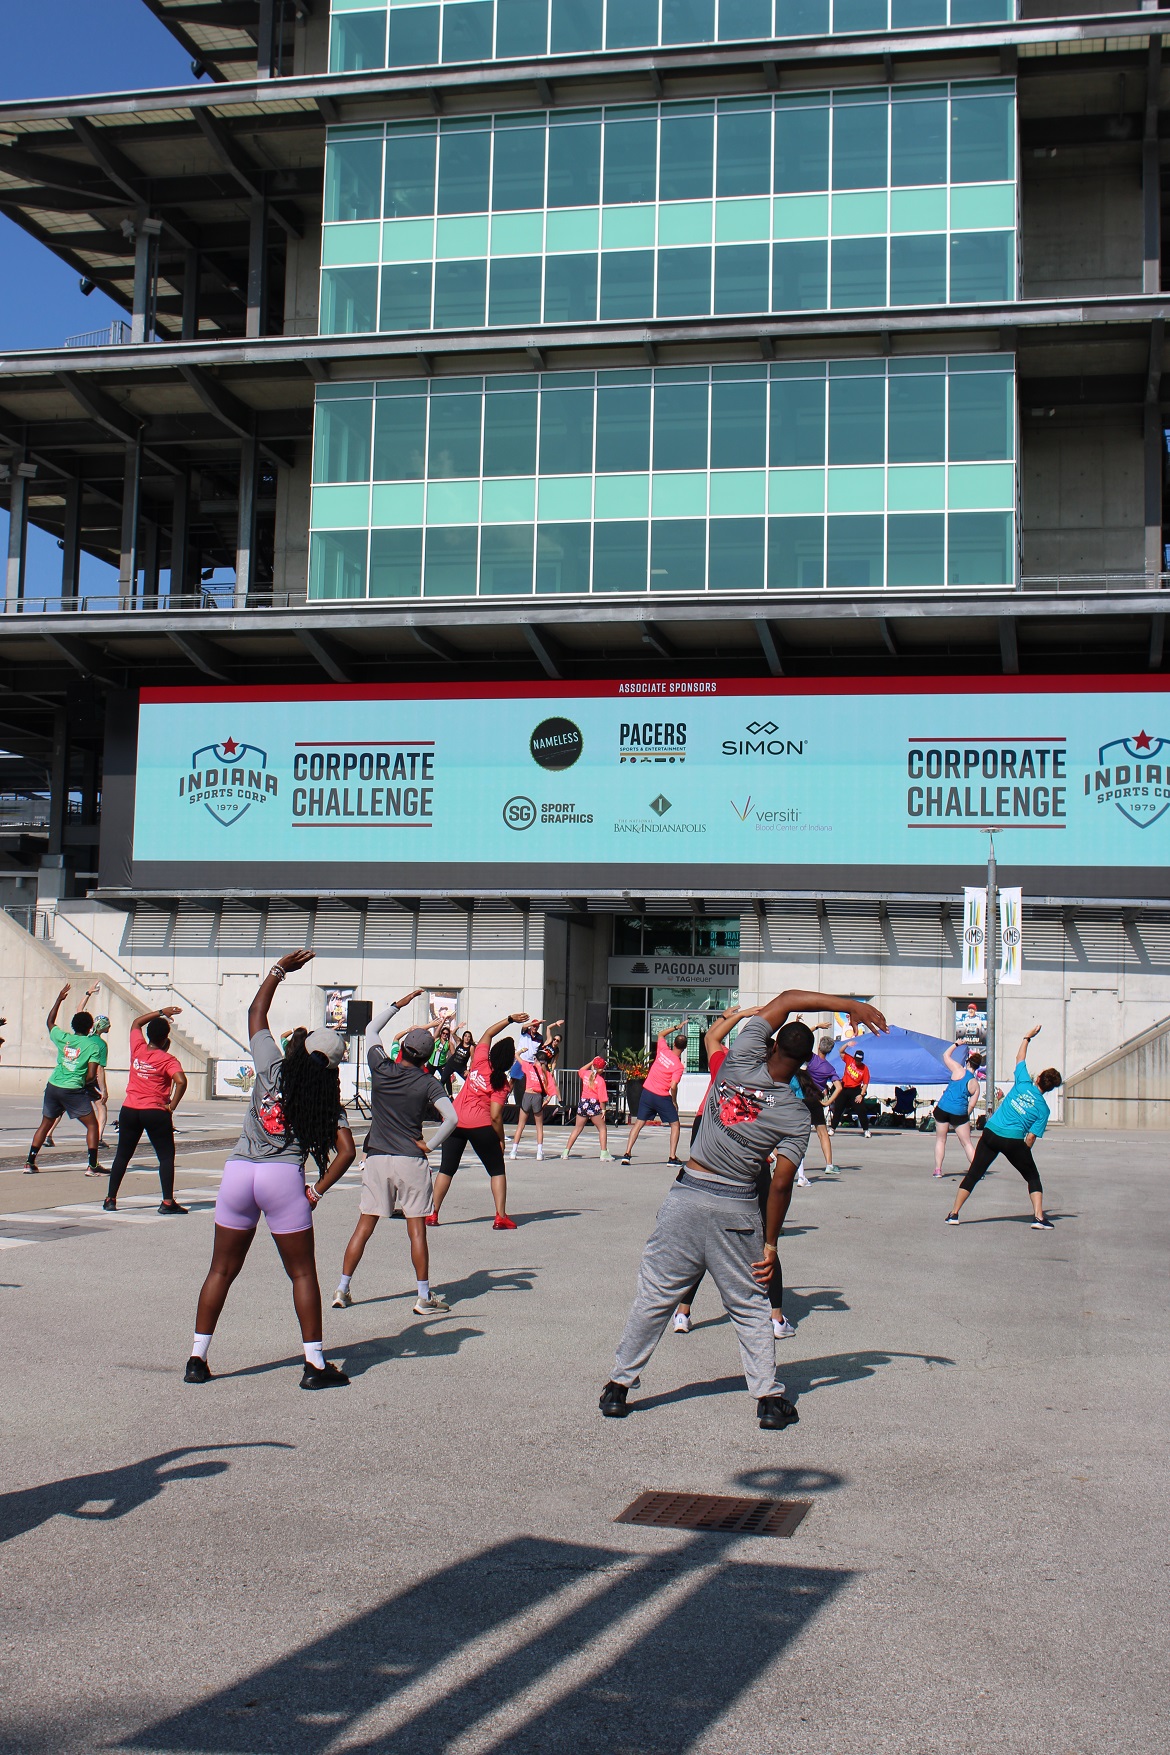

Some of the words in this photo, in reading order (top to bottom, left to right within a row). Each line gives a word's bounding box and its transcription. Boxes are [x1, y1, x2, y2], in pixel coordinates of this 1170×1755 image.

[618, 683, 667, 693] ASSOCIATE
[669, 682, 717, 692] SPONSORS
[533, 731, 579, 750] NAMELESS
[620, 723, 687, 746] PACERS
[293, 753, 434, 780] CORPORATE
[908, 750, 1067, 779] CORPORATE
[179, 768, 278, 797] INDIANA
[1084, 764, 1170, 796] INDIA
[189, 789, 233, 804] SPORTS
[237, 789, 267, 803] CORP
[292, 788, 433, 816] CHALLENGE
[907, 786, 1067, 817] CHALLENGE
[1097, 787, 1149, 803] SPORTS
[508, 805, 531, 822] SG
[541, 803, 576, 813] SPORT
[541, 814, 594, 823] GRAPHICS
[968, 930, 981, 944] IMS
[1006, 931, 1018, 944] IMS
[654, 963, 705, 975] PAGODA
